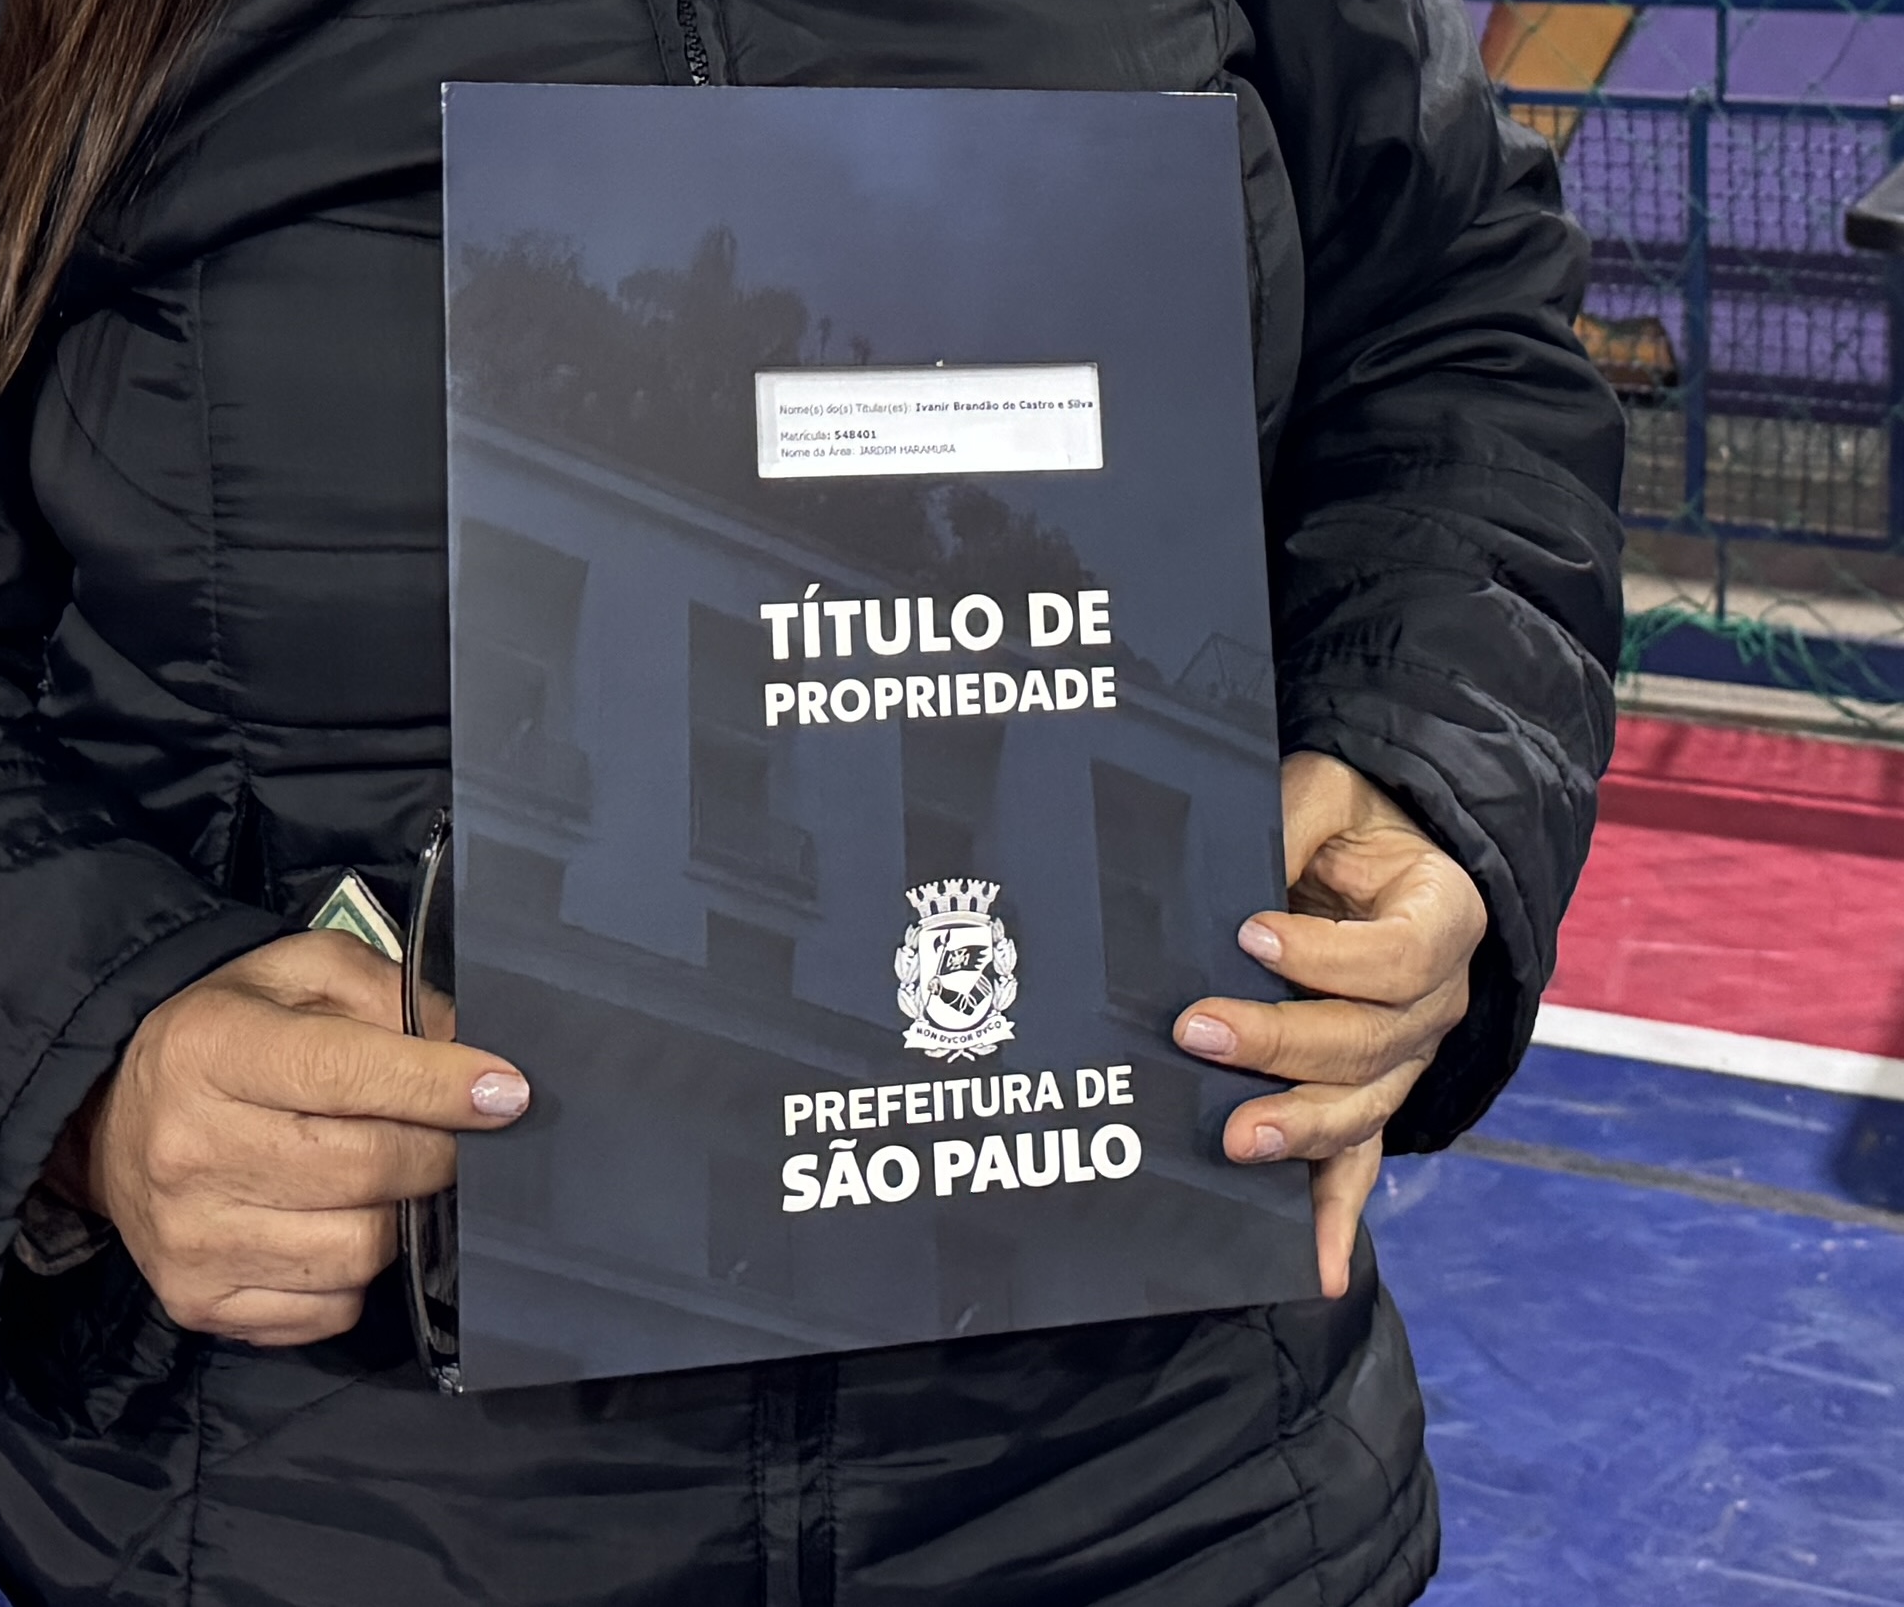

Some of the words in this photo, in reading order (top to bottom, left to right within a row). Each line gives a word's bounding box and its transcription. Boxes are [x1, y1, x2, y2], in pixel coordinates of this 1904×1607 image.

[834, 429, 877, 440] 548401
[916, 401, 949, 412] Ivanir
[953, 400, 999, 411] Brandão
[1002, 400, 1016, 410] de
[1019, 399, 1055, 410] Castro
[1058, 400, 1064, 409] e
[1067, 399, 1094, 409] Silva
[781, 448, 810, 458] Nome
[813, 448, 826, 457] da
[760, 583, 1003, 660] TÍTULO
[1027, 590, 1112, 647] DE
[764, 666, 1117, 727] PROPRIEDADE
[784, 1069, 1064, 1136] PREFEITURA
[1076, 1065, 1135, 1107] DE
[782, 1139, 921, 1213] SÃO
[934, 1123, 1142, 1197] PAULO
